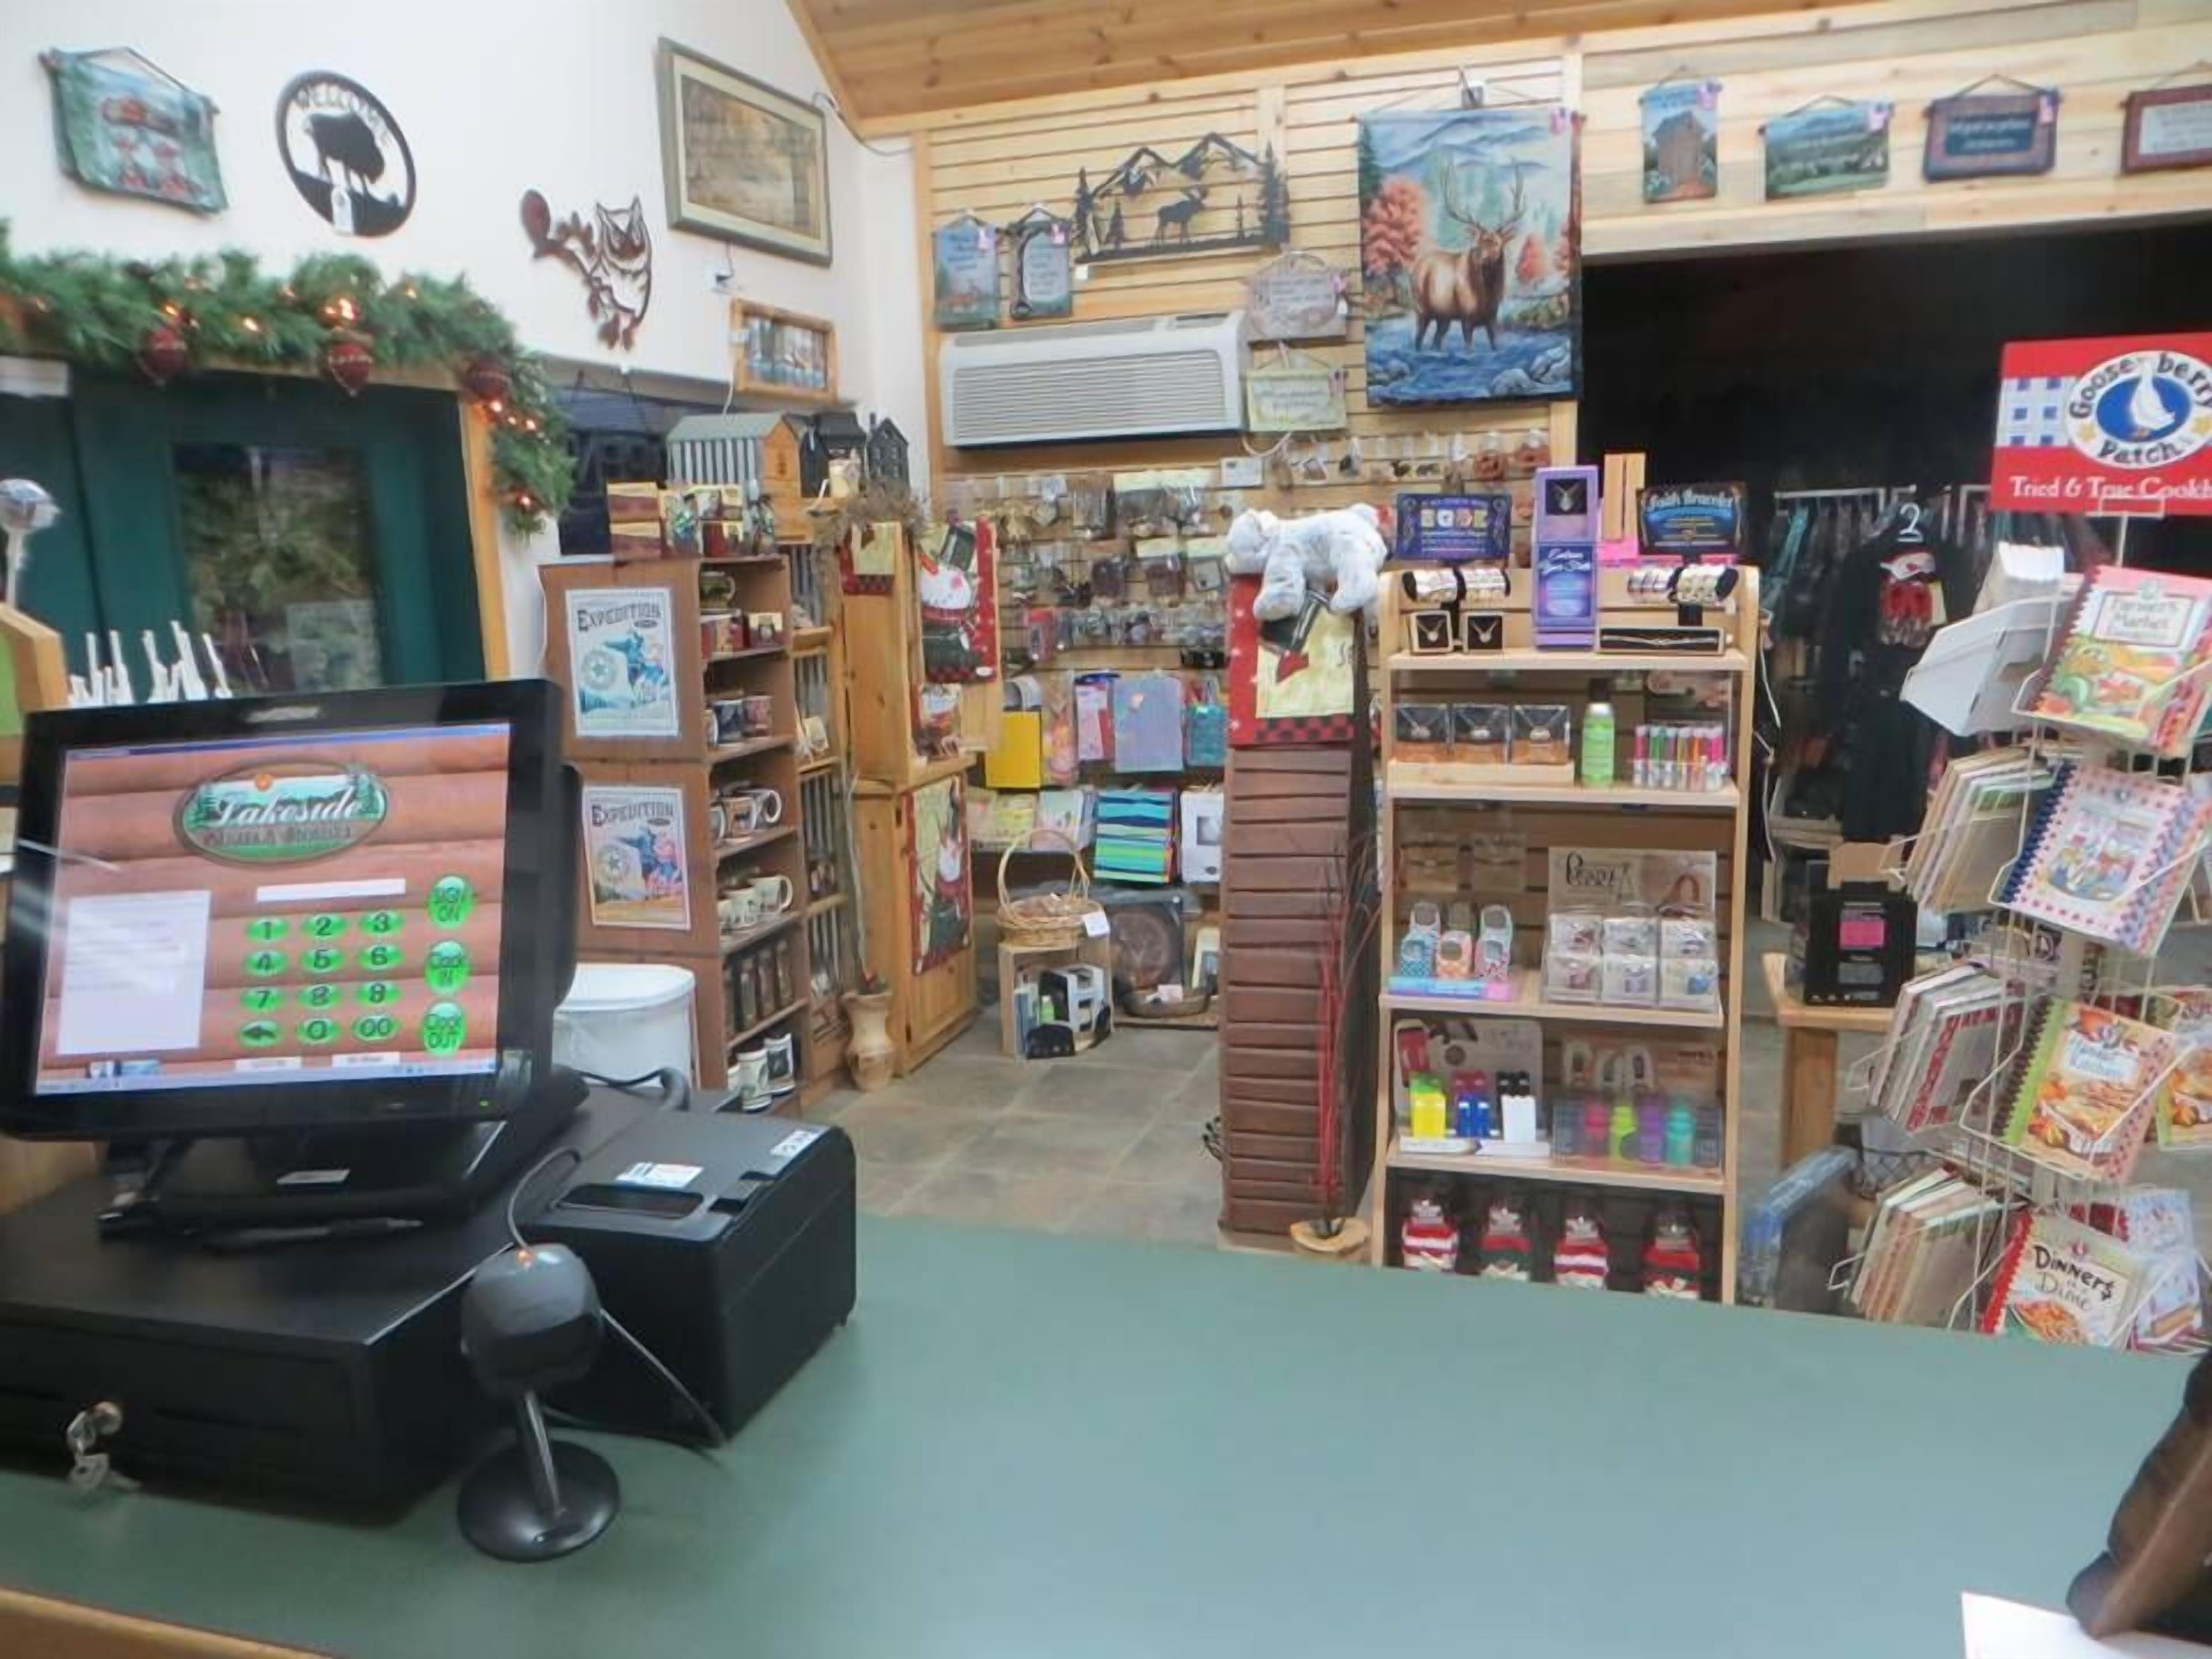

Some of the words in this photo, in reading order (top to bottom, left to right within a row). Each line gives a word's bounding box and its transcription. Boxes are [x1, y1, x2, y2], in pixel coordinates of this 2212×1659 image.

[294, 84, 394, 149] WELCOME
[2009, 476, 2061, 498] Tried
[577, 603, 662, 632] EXPEDITION
[207, 785, 363, 828] Lakeside
[263, 921, 272, 940] 1
[315, 916, 333, 936] 2
[374, 911, 391, 933] 3
[257, 953, 271, 971] 4
[313, 949, 331, 969] 5
[370, 946, 388, 965] 6
[257, 990, 270, 1009] 7
[312, 985, 329, 1007] 8
[306, 1020, 327, 1040] 0
[359, 1018, 392, 1037] 00
[2033, 1244, 2115, 1301] Dinners
